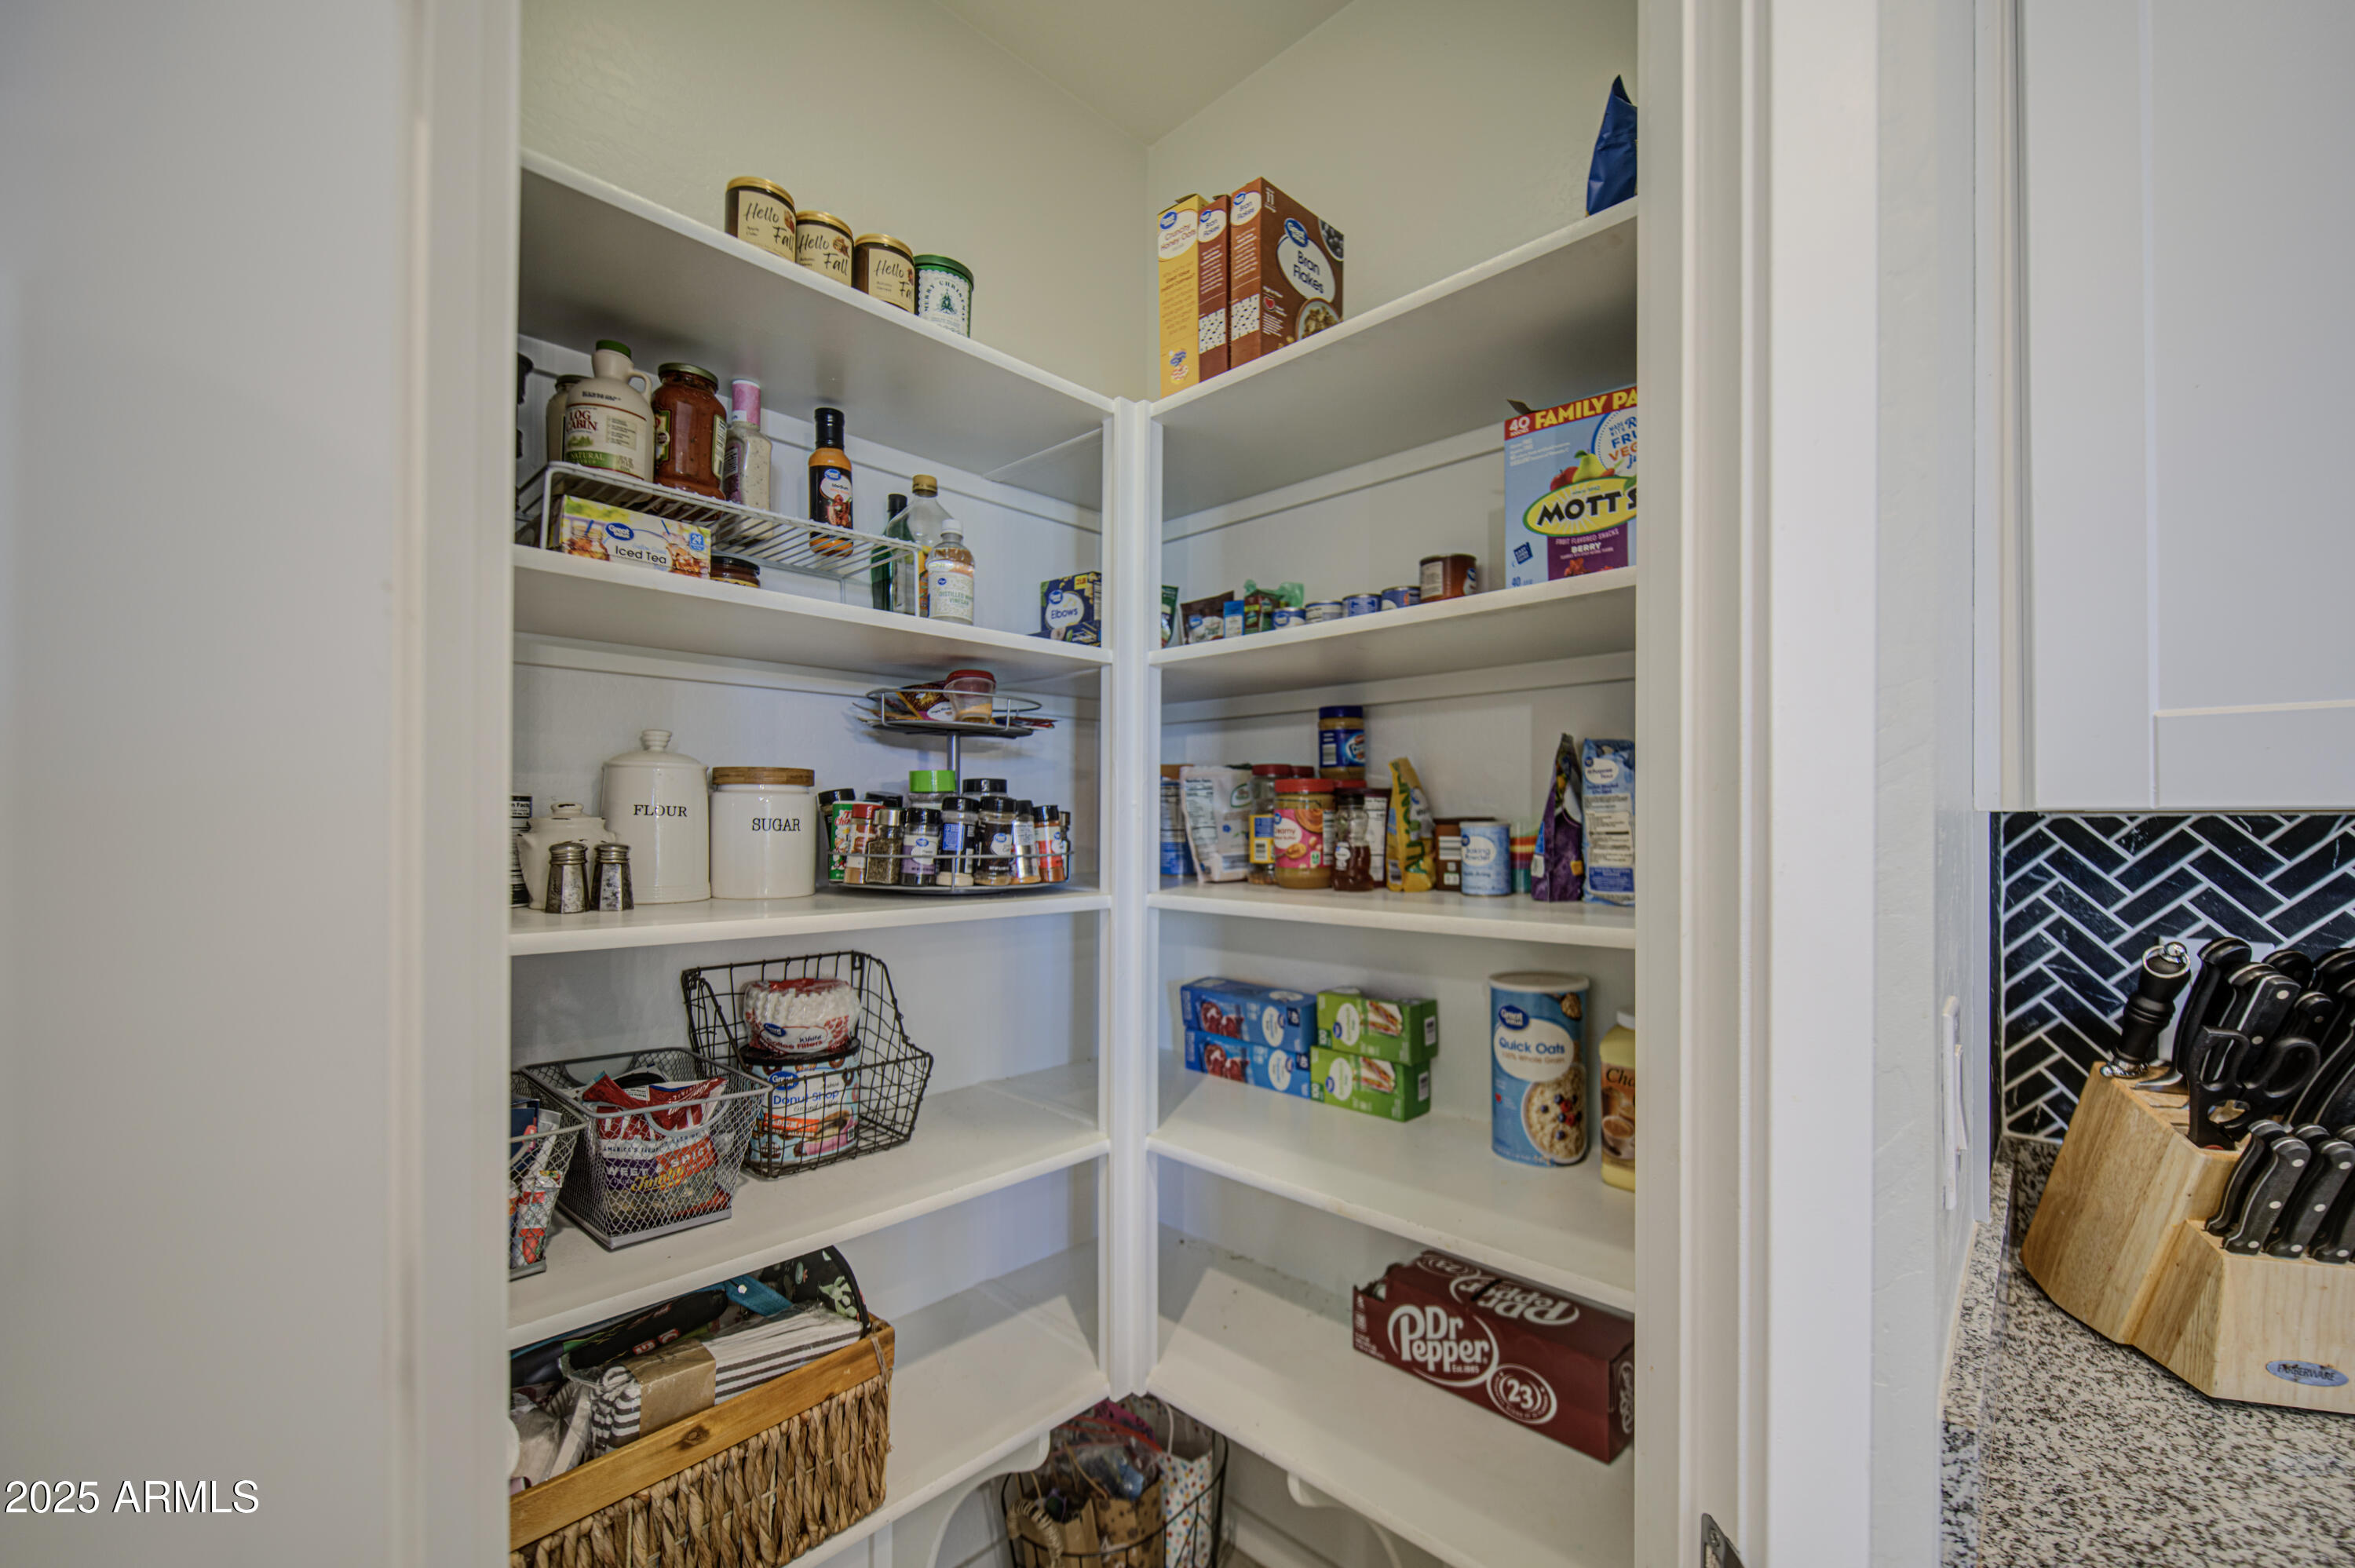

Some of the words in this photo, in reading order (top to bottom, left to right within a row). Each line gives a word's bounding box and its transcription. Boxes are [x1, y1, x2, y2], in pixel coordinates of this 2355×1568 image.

[744, 202, 779, 223] Hello
[772, 225, 794, 253] Fall
[798, 234, 830, 254] Hello
[823, 253, 849, 275] Fall
[874, 260, 904, 277] Hello
[1298, 250, 1320, 275] Bran
[1294, 264, 1324, 294] Flakes
[569, 410, 591, 421] LOG
[1509, 415, 1530, 432] 40
[1535, 395, 1608, 430] FAMILY
[566, 419, 597, 433] CABIN
[571, 451, 604, 461] NATURAL
[692, 534, 703, 545] 24
[1572, 542, 1601, 554] BERRY
[615, 545, 643, 560] Iced
[646, 552, 667, 564] Tea
[1051, 608, 1079, 619] Elbows
[633, 804, 688, 818] FLOUR
[751, 817, 801, 833] SUGAR
[1499, 1037, 1532, 1054] Quick
[1535, 1041, 1565, 1056] Oats
[1425, 1305, 1464, 1340] Dr
[1388, 1304, 1490, 1373] Pepper
[1507, 1377, 1534, 1409] 23
